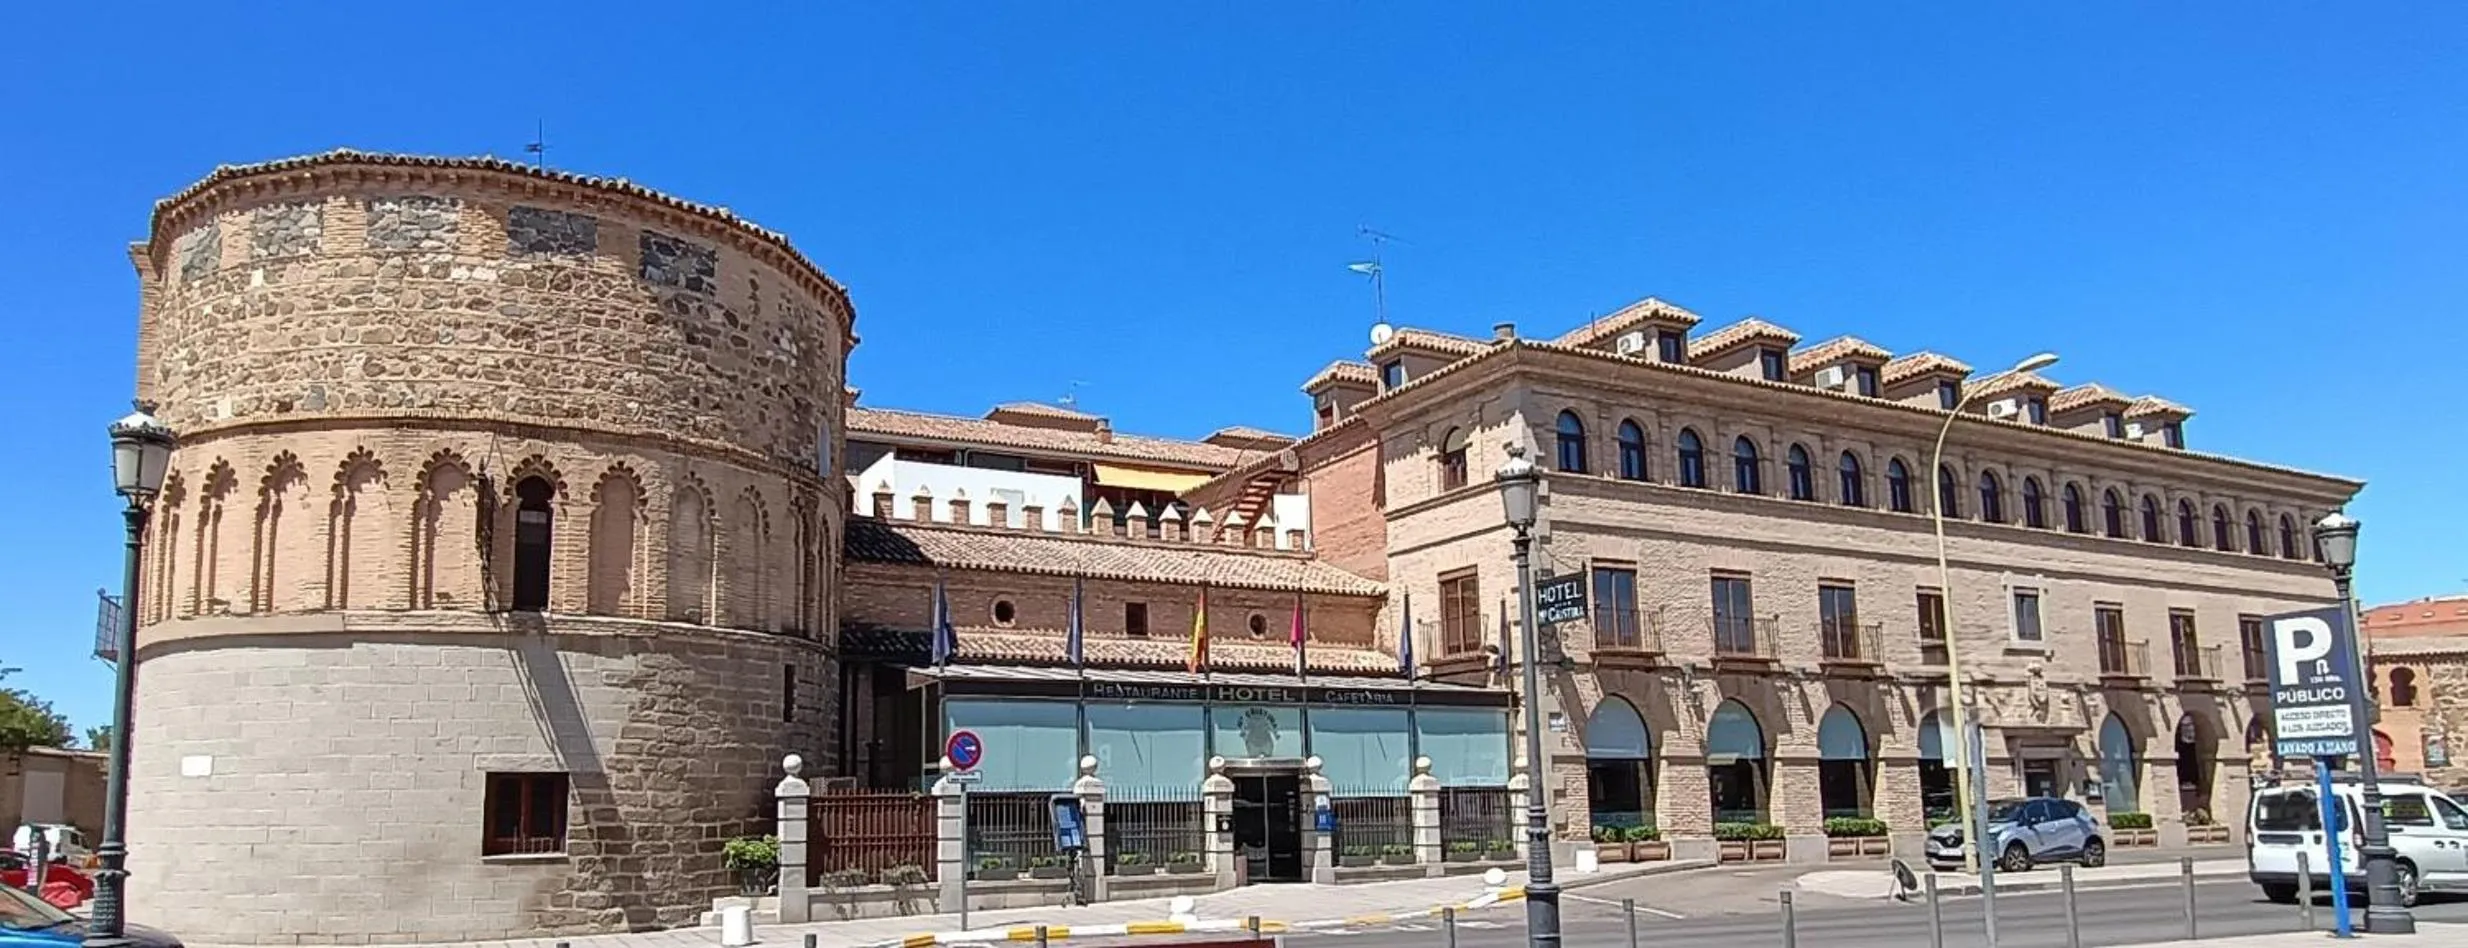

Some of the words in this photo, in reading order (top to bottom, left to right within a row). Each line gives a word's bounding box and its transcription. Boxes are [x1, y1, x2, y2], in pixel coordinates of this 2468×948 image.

[1538, 582, 1583, 605] HOTEL
[2274, 617, 2332, 685] P
[1218, 686, 1295, 701] HOTEL
[2276, 687, 2345, 703] PÚBLICO
